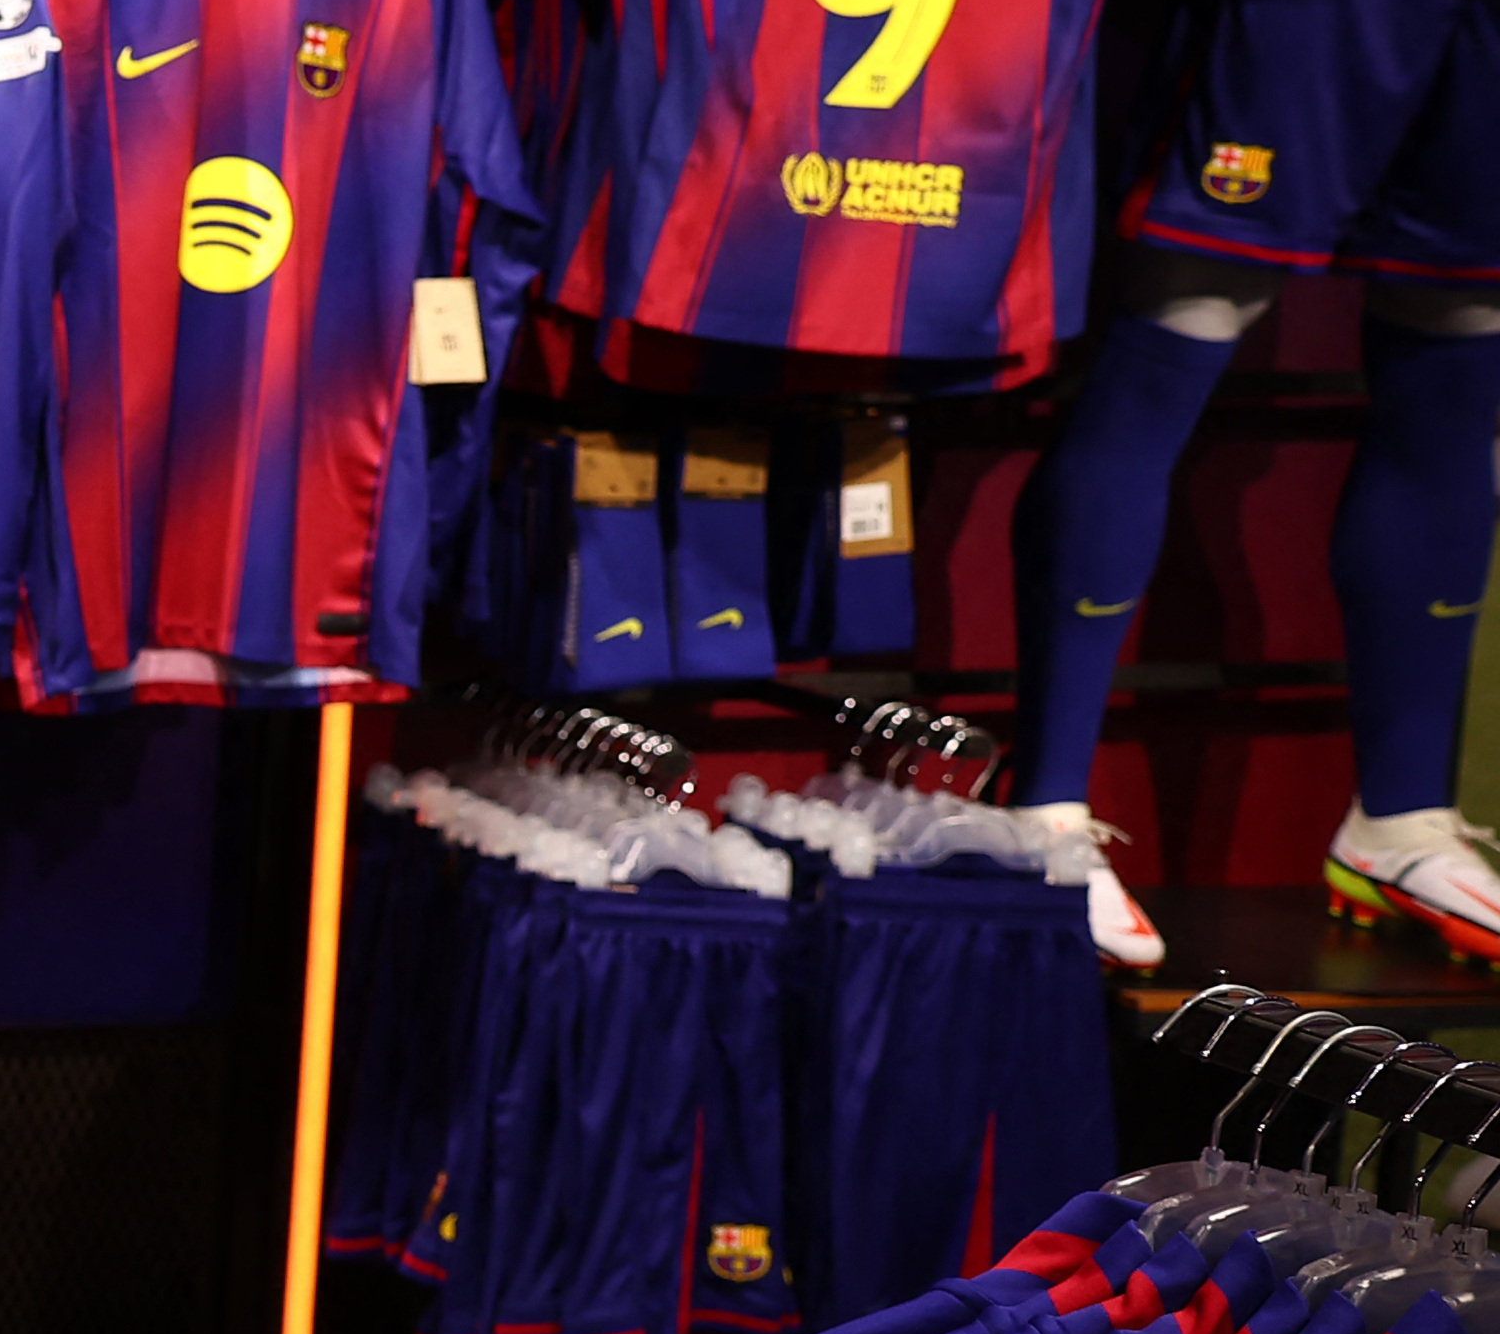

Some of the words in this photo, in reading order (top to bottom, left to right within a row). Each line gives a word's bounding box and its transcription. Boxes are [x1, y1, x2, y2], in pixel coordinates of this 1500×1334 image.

[845, 158, 964, 191] UNHCR
[840, 185, 961, 216] ACNUR
[1293, 1182, 1308, 1196] XL
[1357, 1201, 1369, 1214] XL
[1402, 1226, 1418, 1241] XL
[1452, 1240, 1469, 1255] XL
